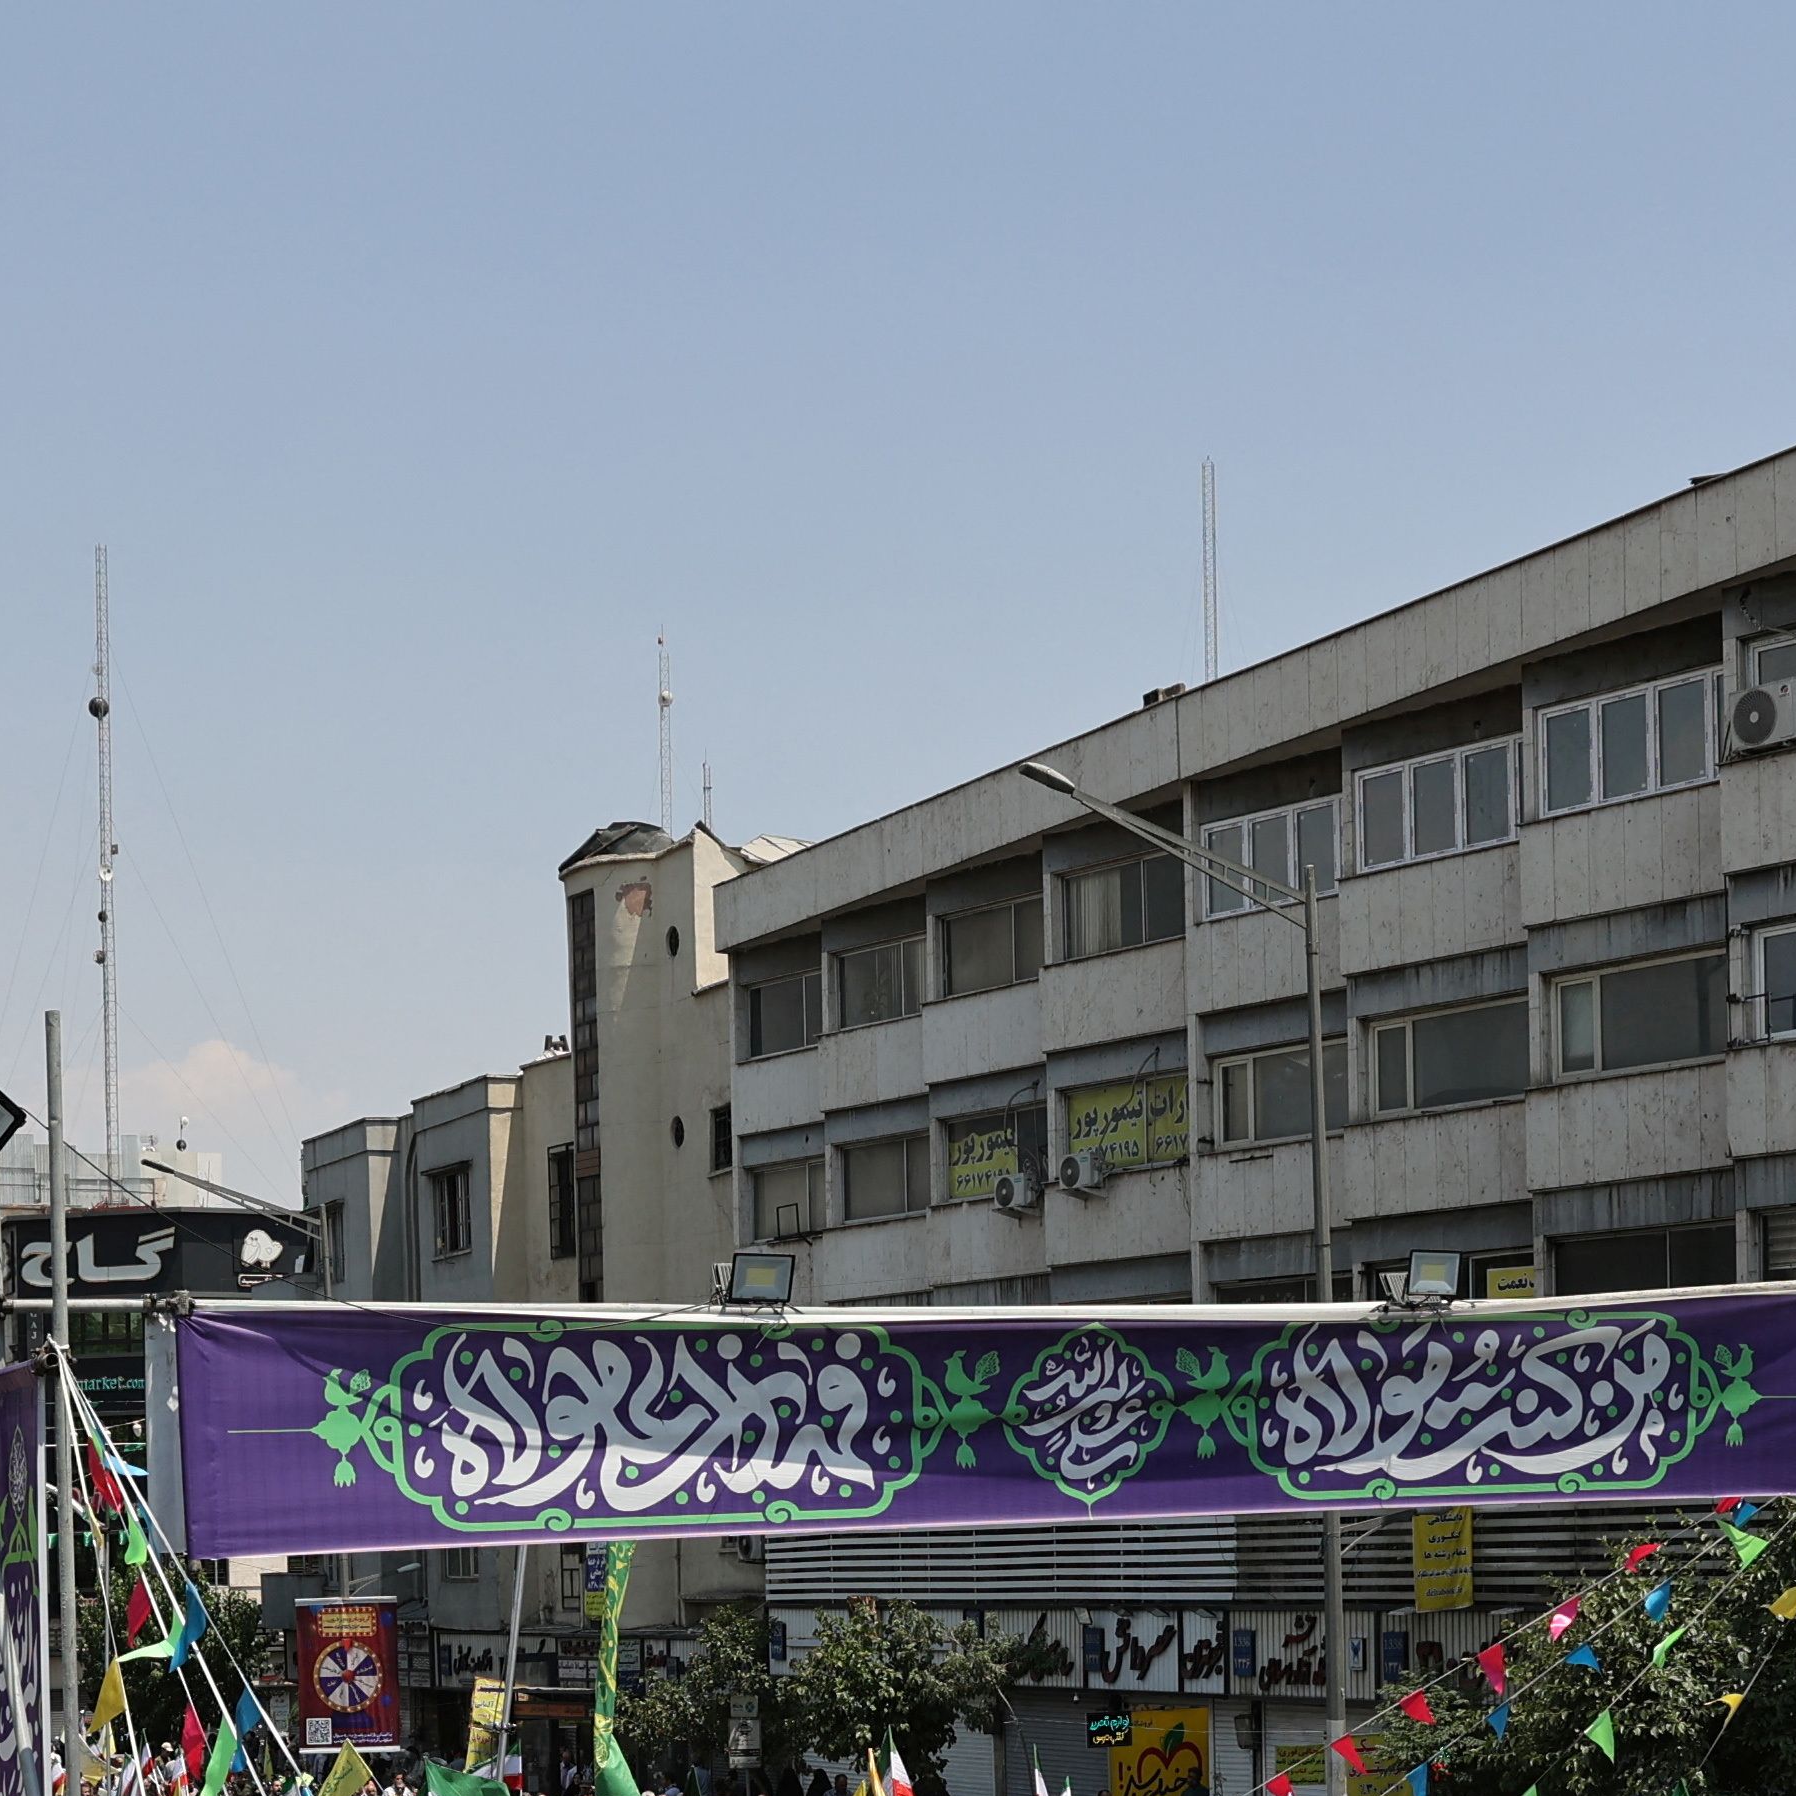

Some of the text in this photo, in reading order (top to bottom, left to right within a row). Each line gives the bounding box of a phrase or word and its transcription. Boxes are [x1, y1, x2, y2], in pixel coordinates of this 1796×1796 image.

[1071, 1089, 1144, 1140] تیمورپور
[21, 1226, 176, 1289] گاج
[75, 1376, 145, 1391] market.com
